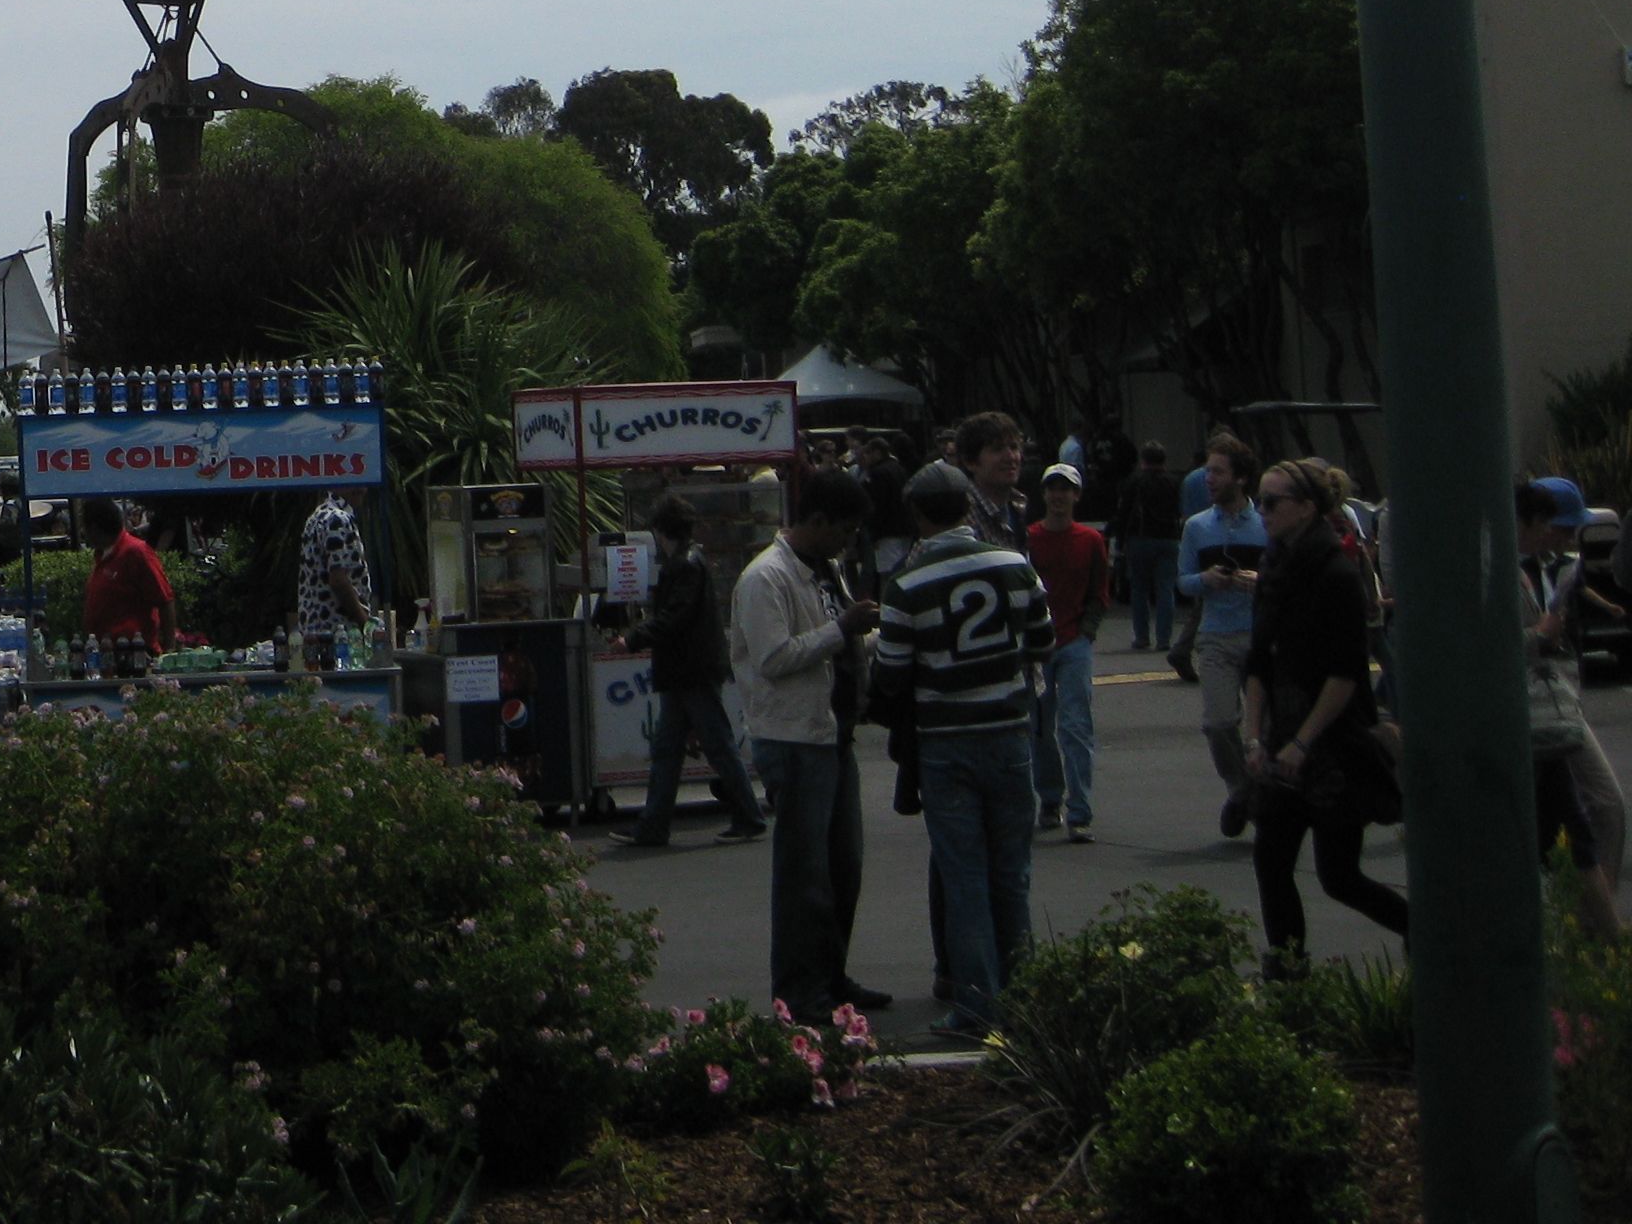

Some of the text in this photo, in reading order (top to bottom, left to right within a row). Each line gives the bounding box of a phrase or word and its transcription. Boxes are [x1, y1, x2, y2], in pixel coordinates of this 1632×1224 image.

[522, 414, 566, 444] CHURROS
[614, 408, 761, 442] CHURROS
[36, 444, 367, 480] ICE COLD DRINKS
[950, 579, 1009, 652] 2
